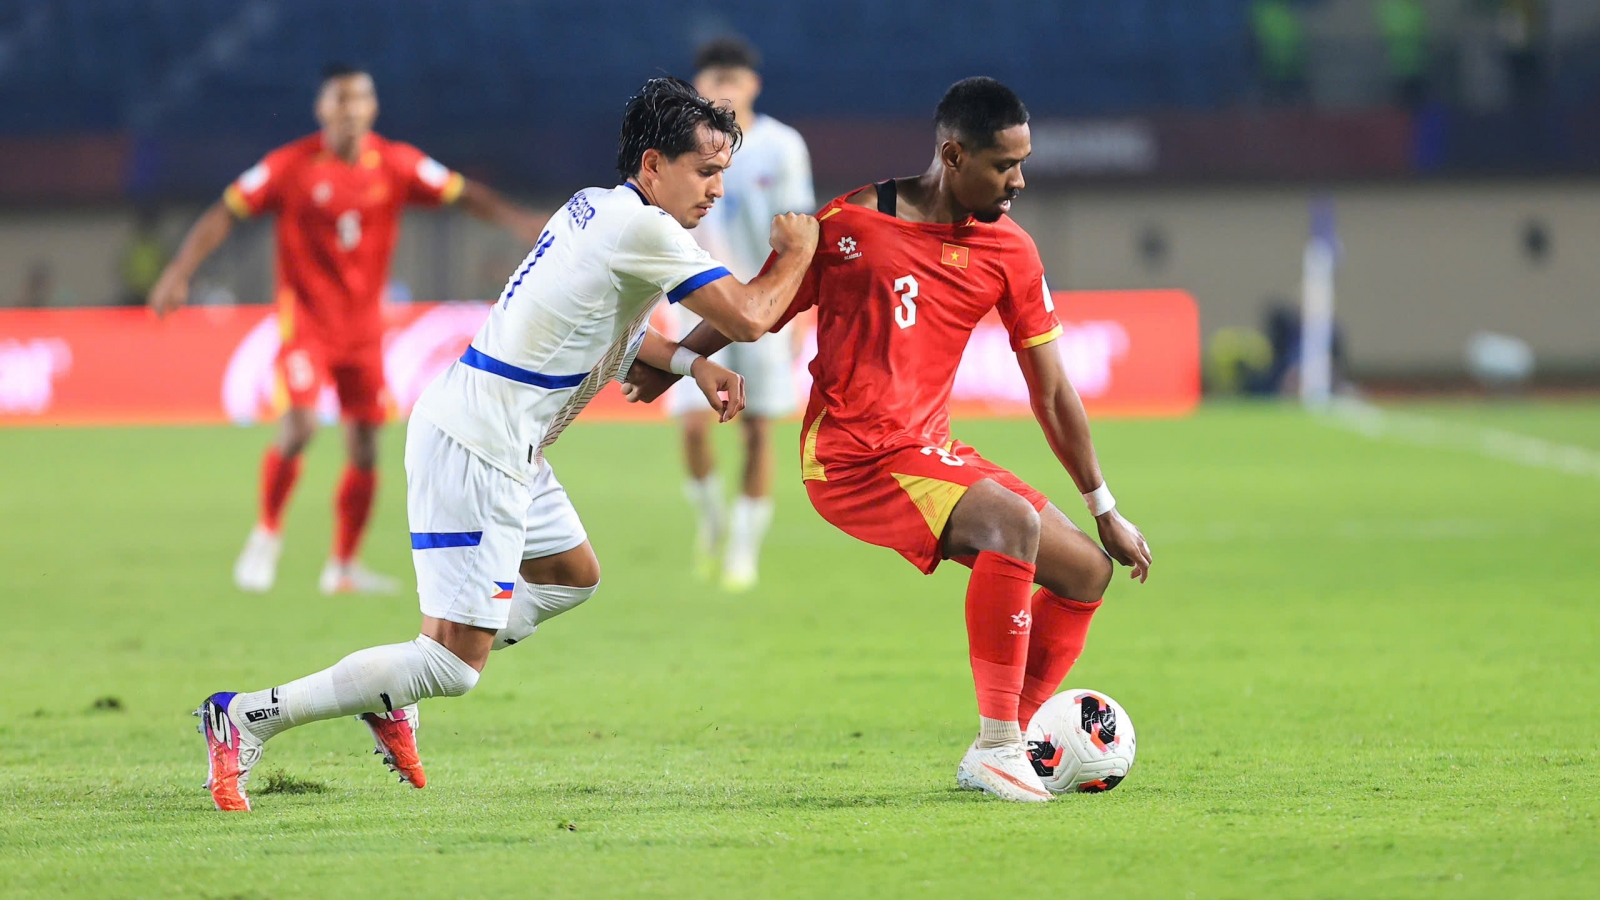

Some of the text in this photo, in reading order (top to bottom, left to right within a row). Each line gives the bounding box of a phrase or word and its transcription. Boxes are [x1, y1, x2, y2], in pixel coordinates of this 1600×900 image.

[503, 229, 555, 311] 1
[893, 274, 919, 330] 3
[919, 446, 966, 466] 3
